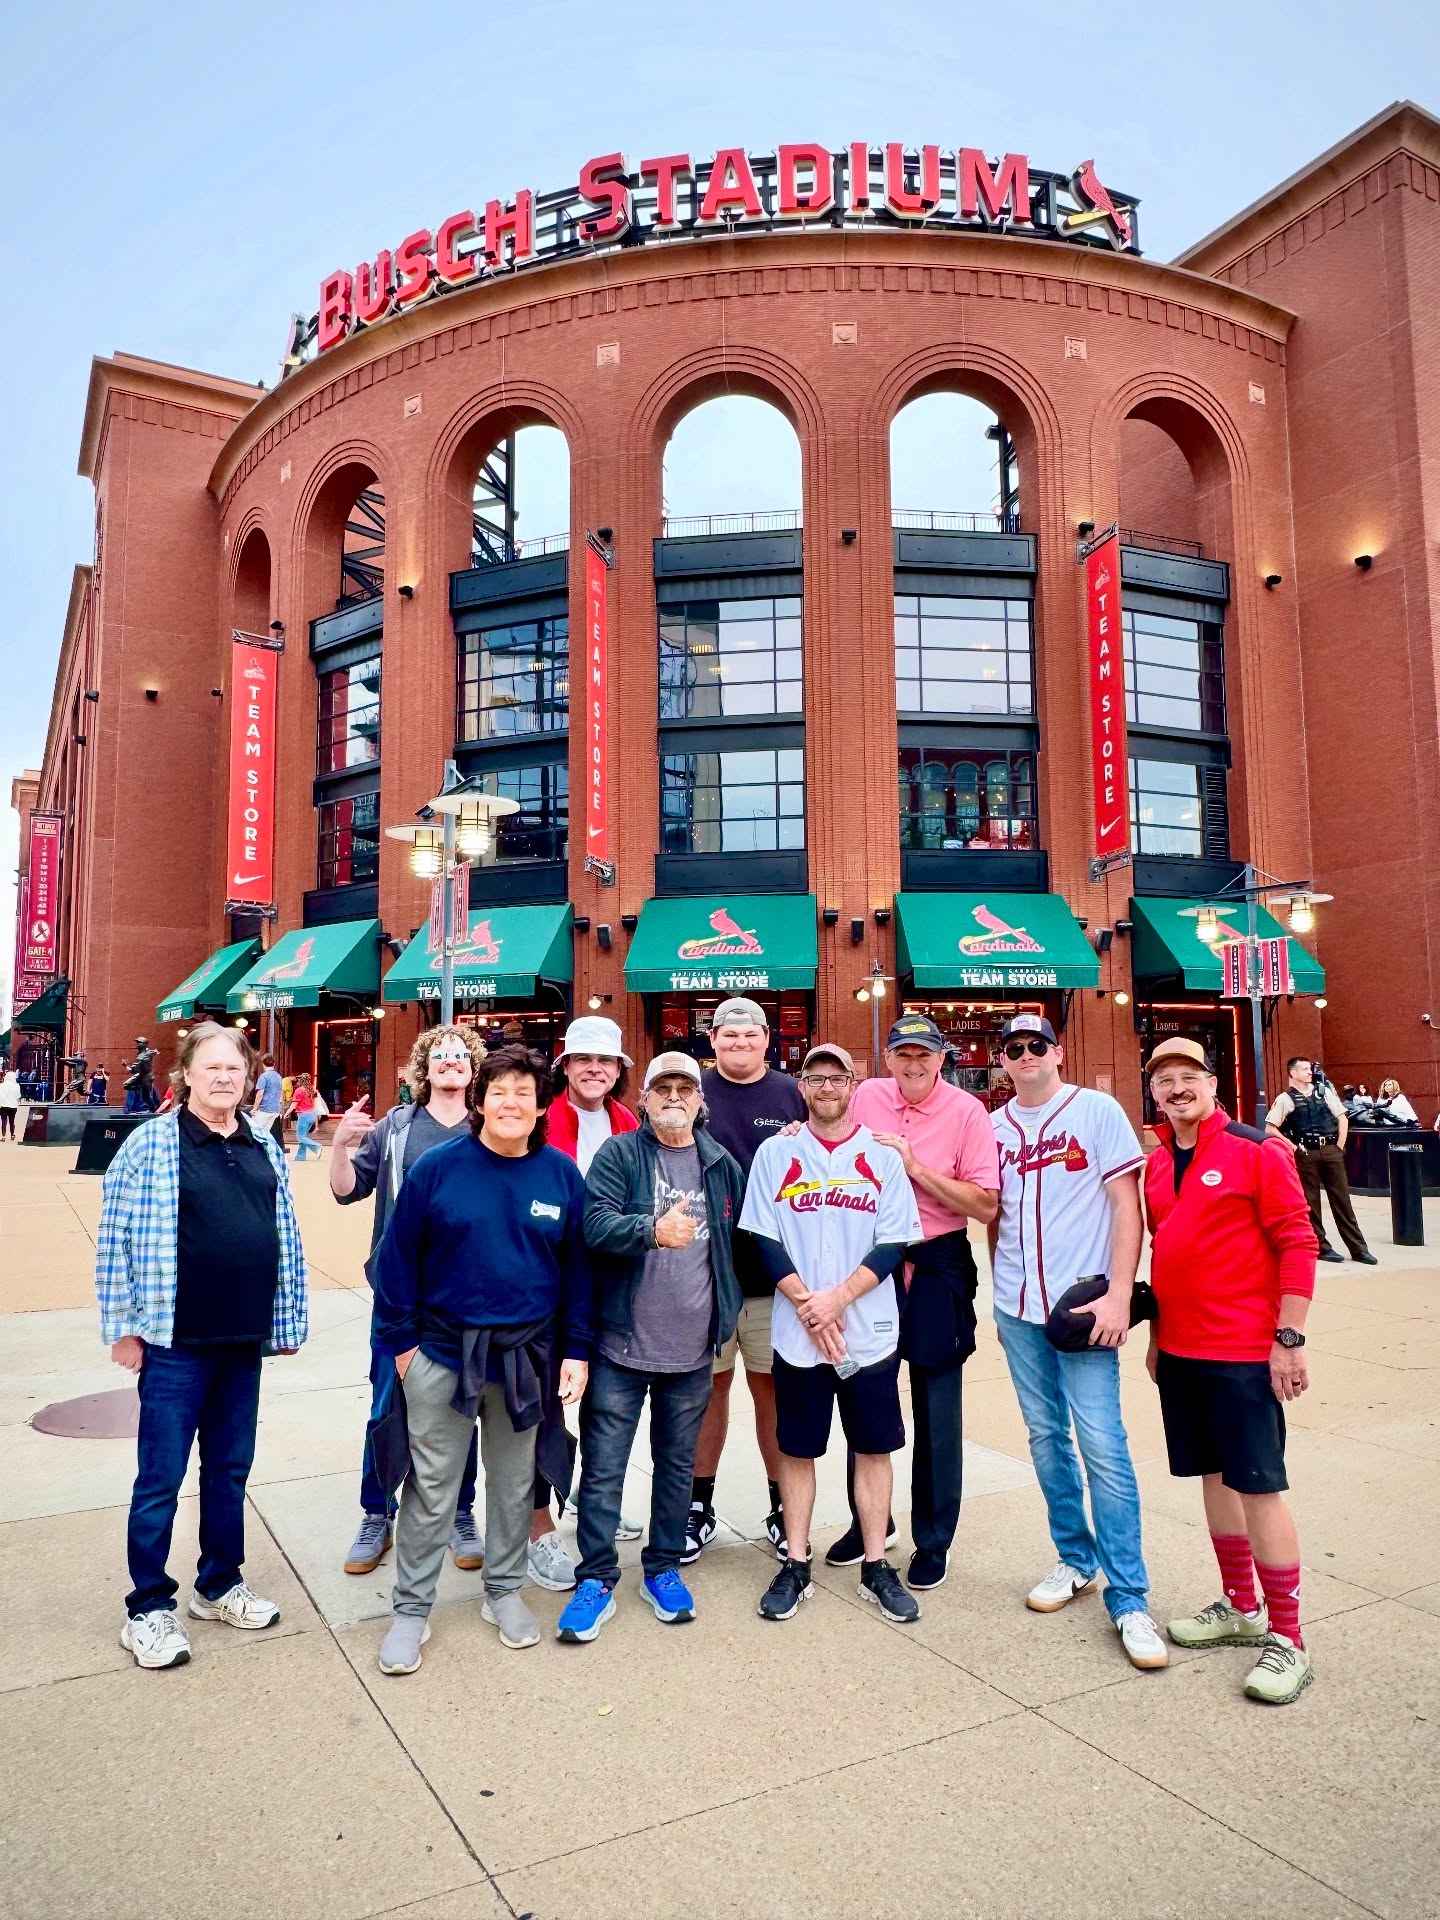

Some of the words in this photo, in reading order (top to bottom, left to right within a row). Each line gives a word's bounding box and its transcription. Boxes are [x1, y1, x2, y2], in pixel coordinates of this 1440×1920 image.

[318, 188, 539, 353] BUSCH
[578, 141, 1034, 243] STADIUM
[593, 599, 601, 687] TEAM
[1098, 593, 1111, 681] TEAM
[245, 685, 261, 758] TEAM
[593, 701, 601, 810] STORE
[1101, 694, 1115, 804] STORE
[244, 769, 260, 861] STORE
[678, 940, 764, 960] Cardinals
[959, 936, 1045, 956] Cardinals
[417, 985, 442, 998] TEA
[454, 983, 497, 997] STORE
[670, 976, 713, 989] TEAM
[718, 975, 769, 988] STORE
[961, 973, 1004, 986] TEAM
[1008, 973, 1057, 986] STORE
[950, 1020, 981, 1030] LADIES
[1155, 1022, 1179, 1031] LADIES
[789, 1181, 877, 1214] Cardinals
